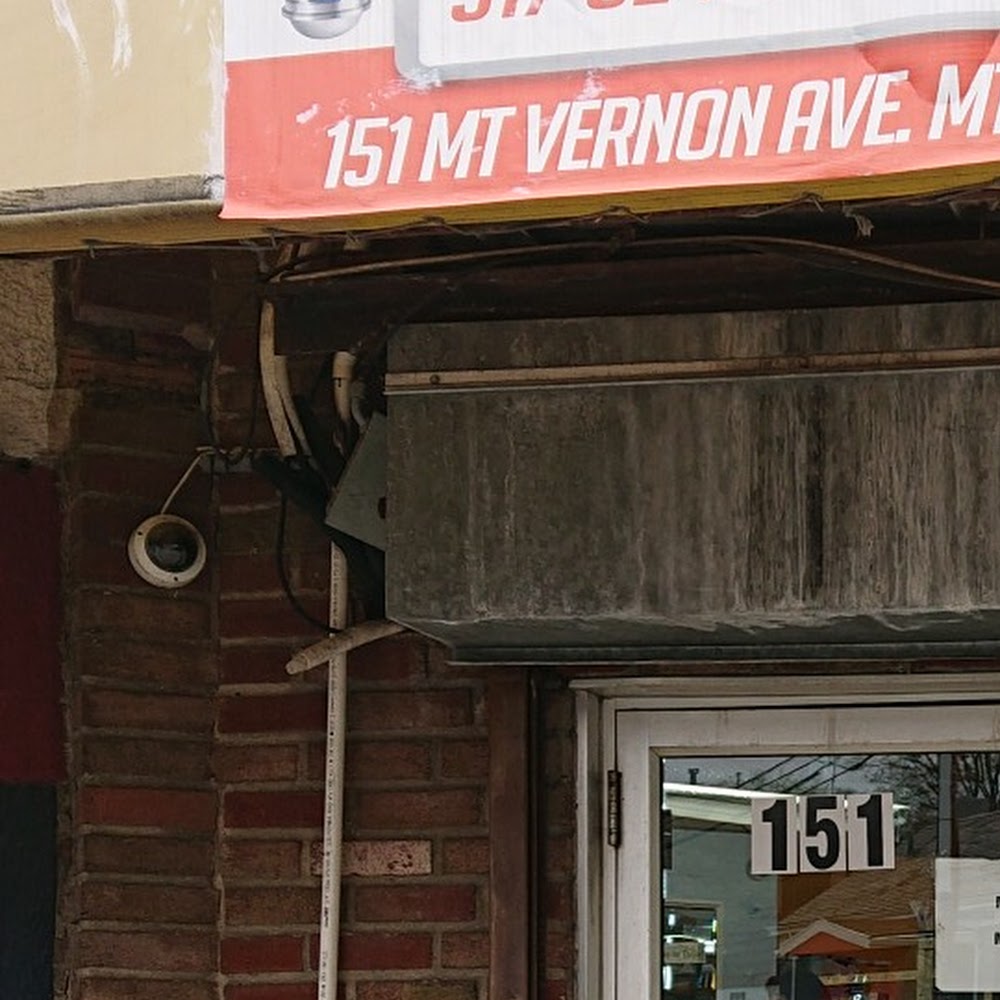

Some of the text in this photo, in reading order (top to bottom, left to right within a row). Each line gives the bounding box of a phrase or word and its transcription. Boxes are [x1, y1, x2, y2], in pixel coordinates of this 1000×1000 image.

[323, 114, 413, 189] 151
[418, 106, 517, 182] MT
[526, 84, 773, 174] VERNON
[777, 69, 911, 154] AVE.
[762, 794, 884, 870] 151
